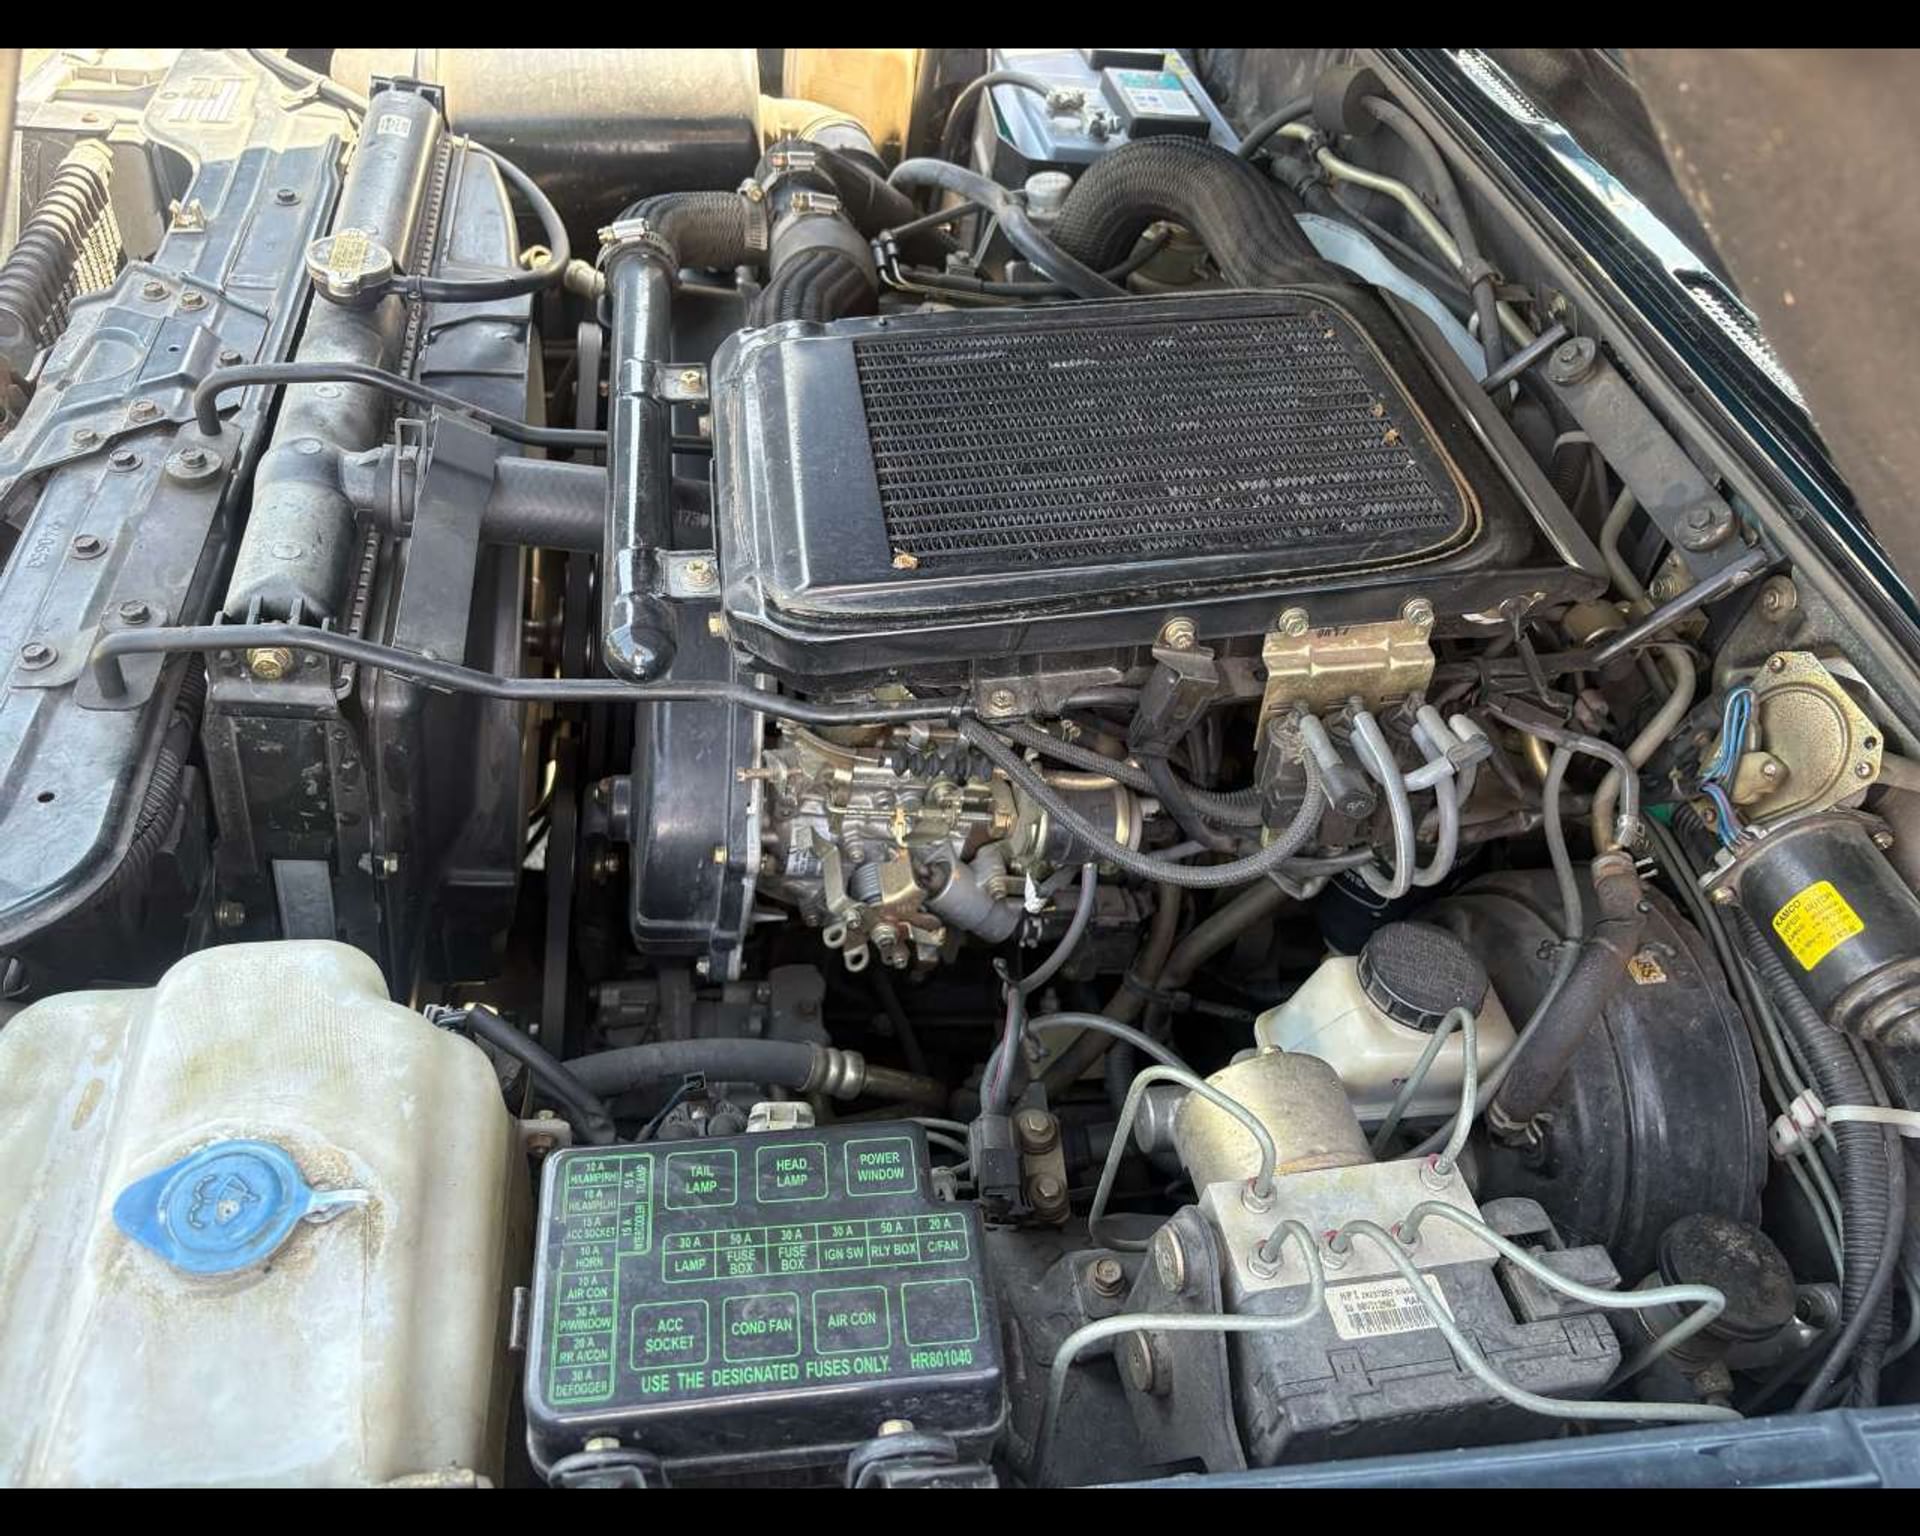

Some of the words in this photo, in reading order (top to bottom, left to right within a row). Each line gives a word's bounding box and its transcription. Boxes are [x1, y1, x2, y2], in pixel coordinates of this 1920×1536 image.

[776, 1158, 807, 1171] HEAD
[859, 1152, 900, 1165] POWER
[690, 1165, 715, 1178] TAIL
[857, 1167, 905, 1181] WINDOW
[685, 1181, 718, 1194] LAMP
[777, 1174, 808, 1188] LAMP
[596, 1189, 603, 1198] A
[594, 1217, 601, 1226] A
[880, 1222, 893, 1233] 50
[895, 1221, 903, 1233] A
[943, 1218, 952, 1229] A
[584, 1226, 616, 1238] SOCKET
[744, 1232, 753, 1243] A
[781, 1229, 793, 1241] 30
[795, 1229, 803, 1240] A
[832, 1226, 844, 1237] 30
[846, 1225, 854, 1236] A
[679, 1237, 691, 1248] 30
[692, 1236, 701, 1248] A
[927, 1239, 959, 1253] C/FAN
[592, 1245, 600, 1255] A
[727, 1248, 756, 1262] FUSE
[778, 1245, 807, 1259] FUSE
[824, 1249, 844, 1261] IGN
[846, 1246, 864, 1259] SW
[871, 1244, 891, 1257] RLY
[893, 1242, 918, 1256] BOX
[576, 1258, 603, 1269] HORN
[674, 1258, 706, 1272] LAMP
[729, 1262, 754, 1275] BOX
[781, 1259, 805, 1271] BOX
[592, 1275, 598, 1285] A
[568, 1289, 584, 1298] AIR
[586, 1287, 608, 1298] CON
[589, 1306, 597, 1316] A
[657, 1318, 684, 1333] ACC
[827, 1314, 848, 1328] AIR
[850, 1311, 877, 1326] CON
[731, 1320, 767, 1336] COND
[768, 1318, 793, 1333] FAN
[587, 1337, 595, 1347] A
[645, 1335, 695, 1352] SOCKET
[585, 1368, 593, 1379] A
[641, 1374, 671, 1394] USE
[677, 1371, 705, 1390] THE
[712, 1363, 799, 1387] DESIGNATED
[805, 1359, 850, 1379] FUSES
[853, 1355, 892, 1374] ONLY.
[556, 1381, 608, 1396] DEFOGGER
